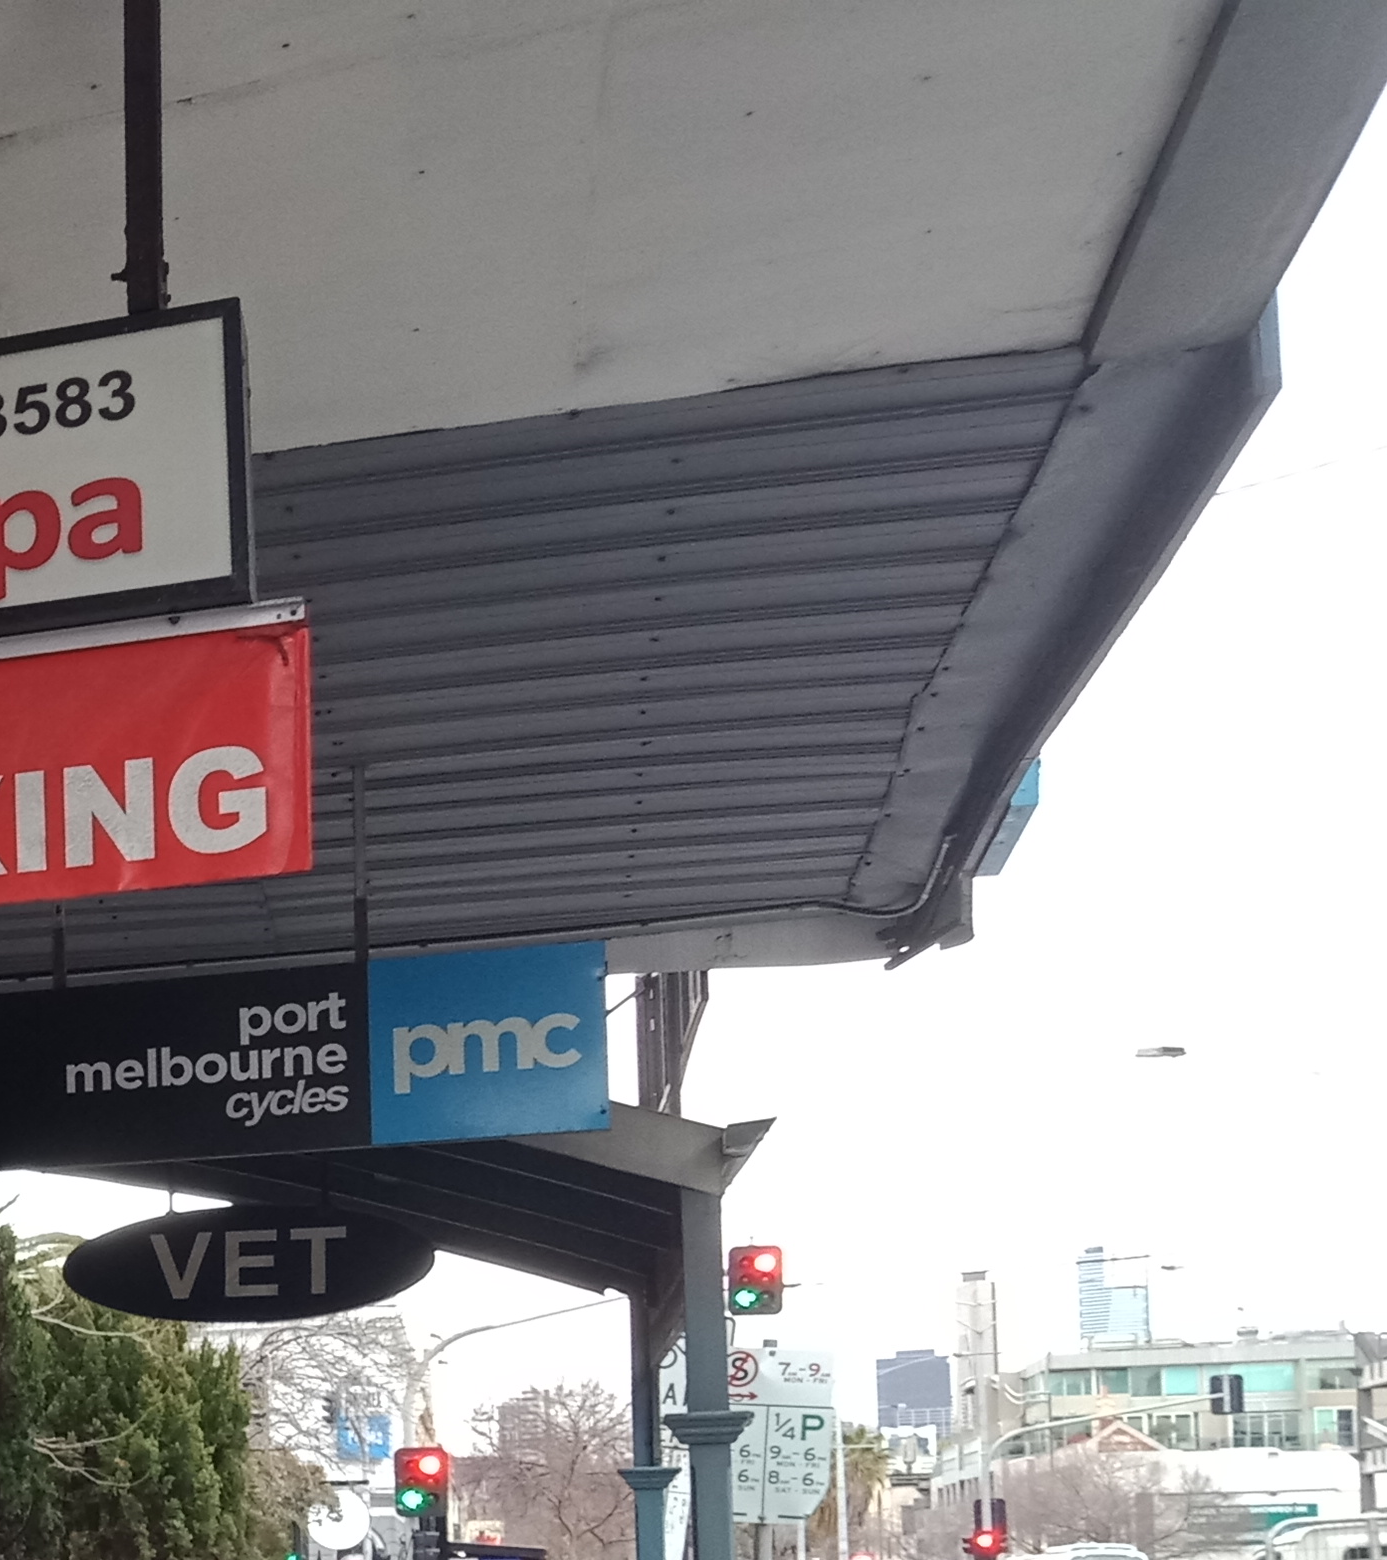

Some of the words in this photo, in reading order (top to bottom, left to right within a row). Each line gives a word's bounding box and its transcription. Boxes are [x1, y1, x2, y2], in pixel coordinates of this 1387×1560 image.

[239, 992, 346, 1045] port
[393, 1013, 582, 1095] pmc
[66, 1044, 348, 1094] melbourne
[225, 1080, 349, 1127] cycles
[149, 1227, 347, 1299] VET
[800, 1414, 824, 1441] P
